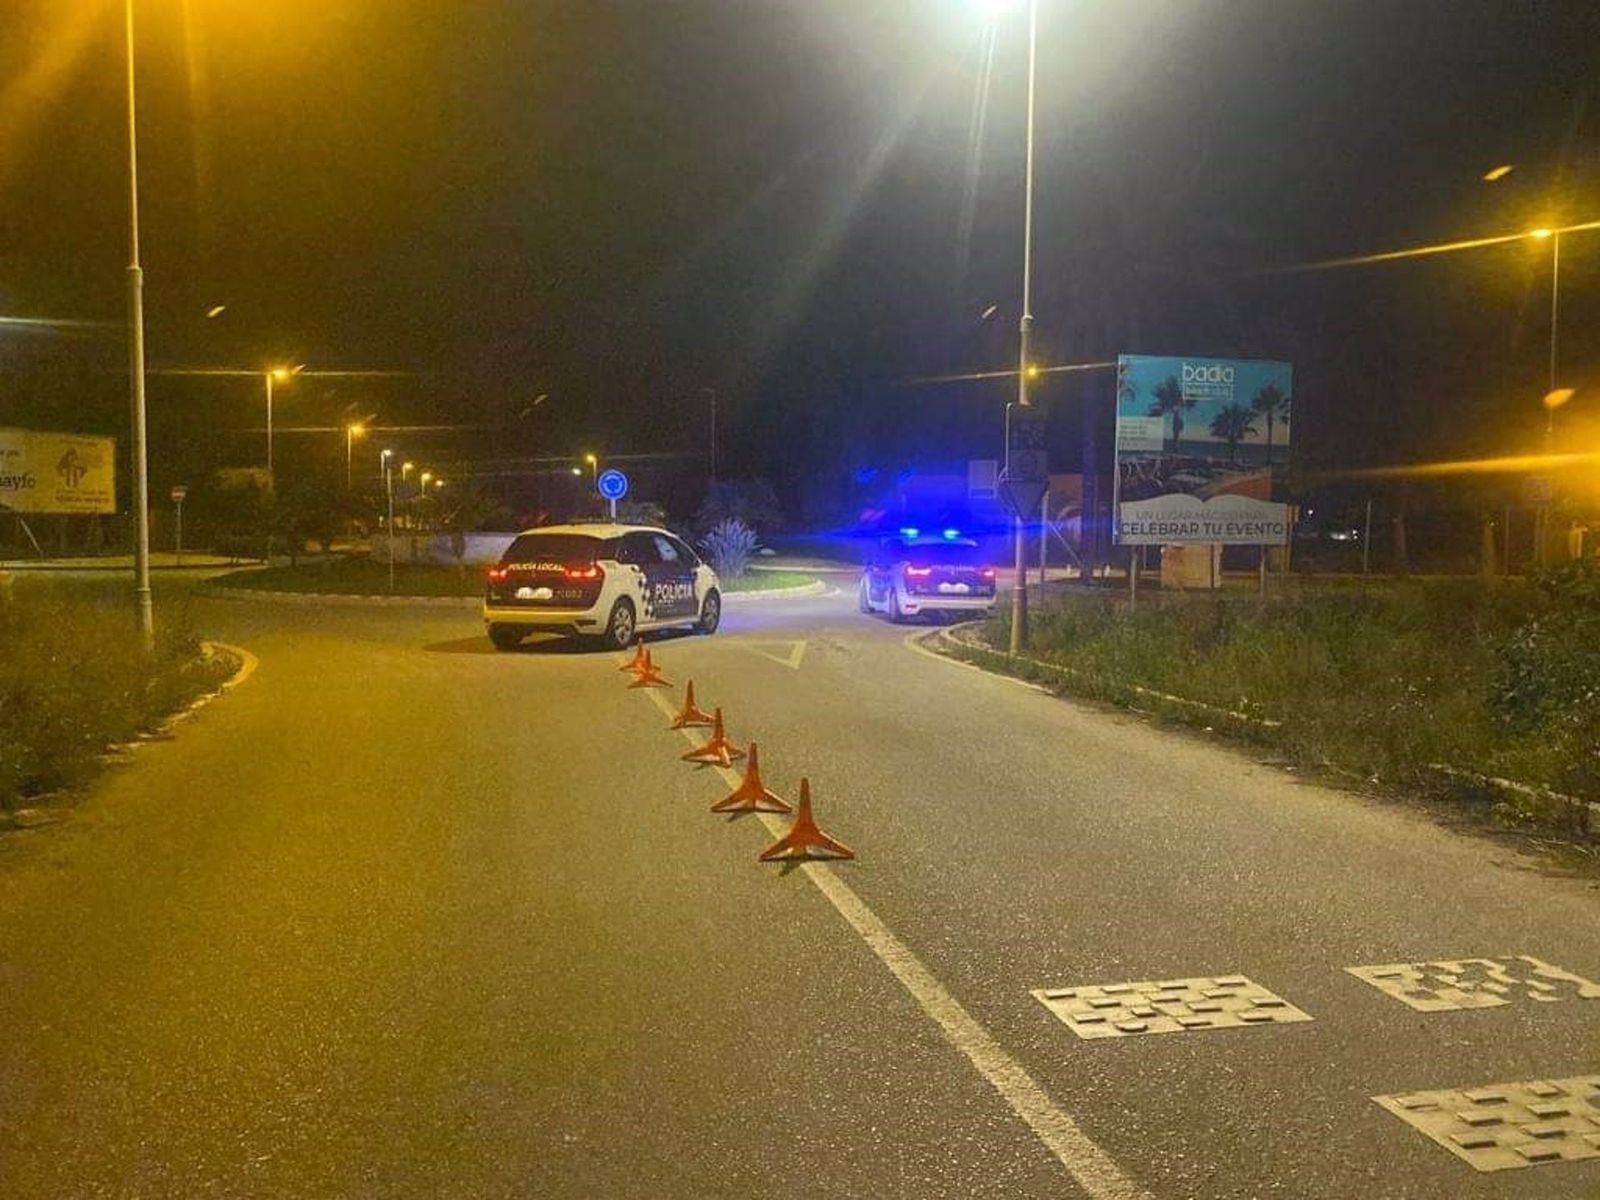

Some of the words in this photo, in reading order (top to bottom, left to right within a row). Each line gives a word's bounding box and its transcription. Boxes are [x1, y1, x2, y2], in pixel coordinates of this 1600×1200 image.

[1121, 522, 1198, 535] CELEBRAR
[1204, 523, 1222, 535] TU
[1227, 522, 1283, 535] EVENTO
